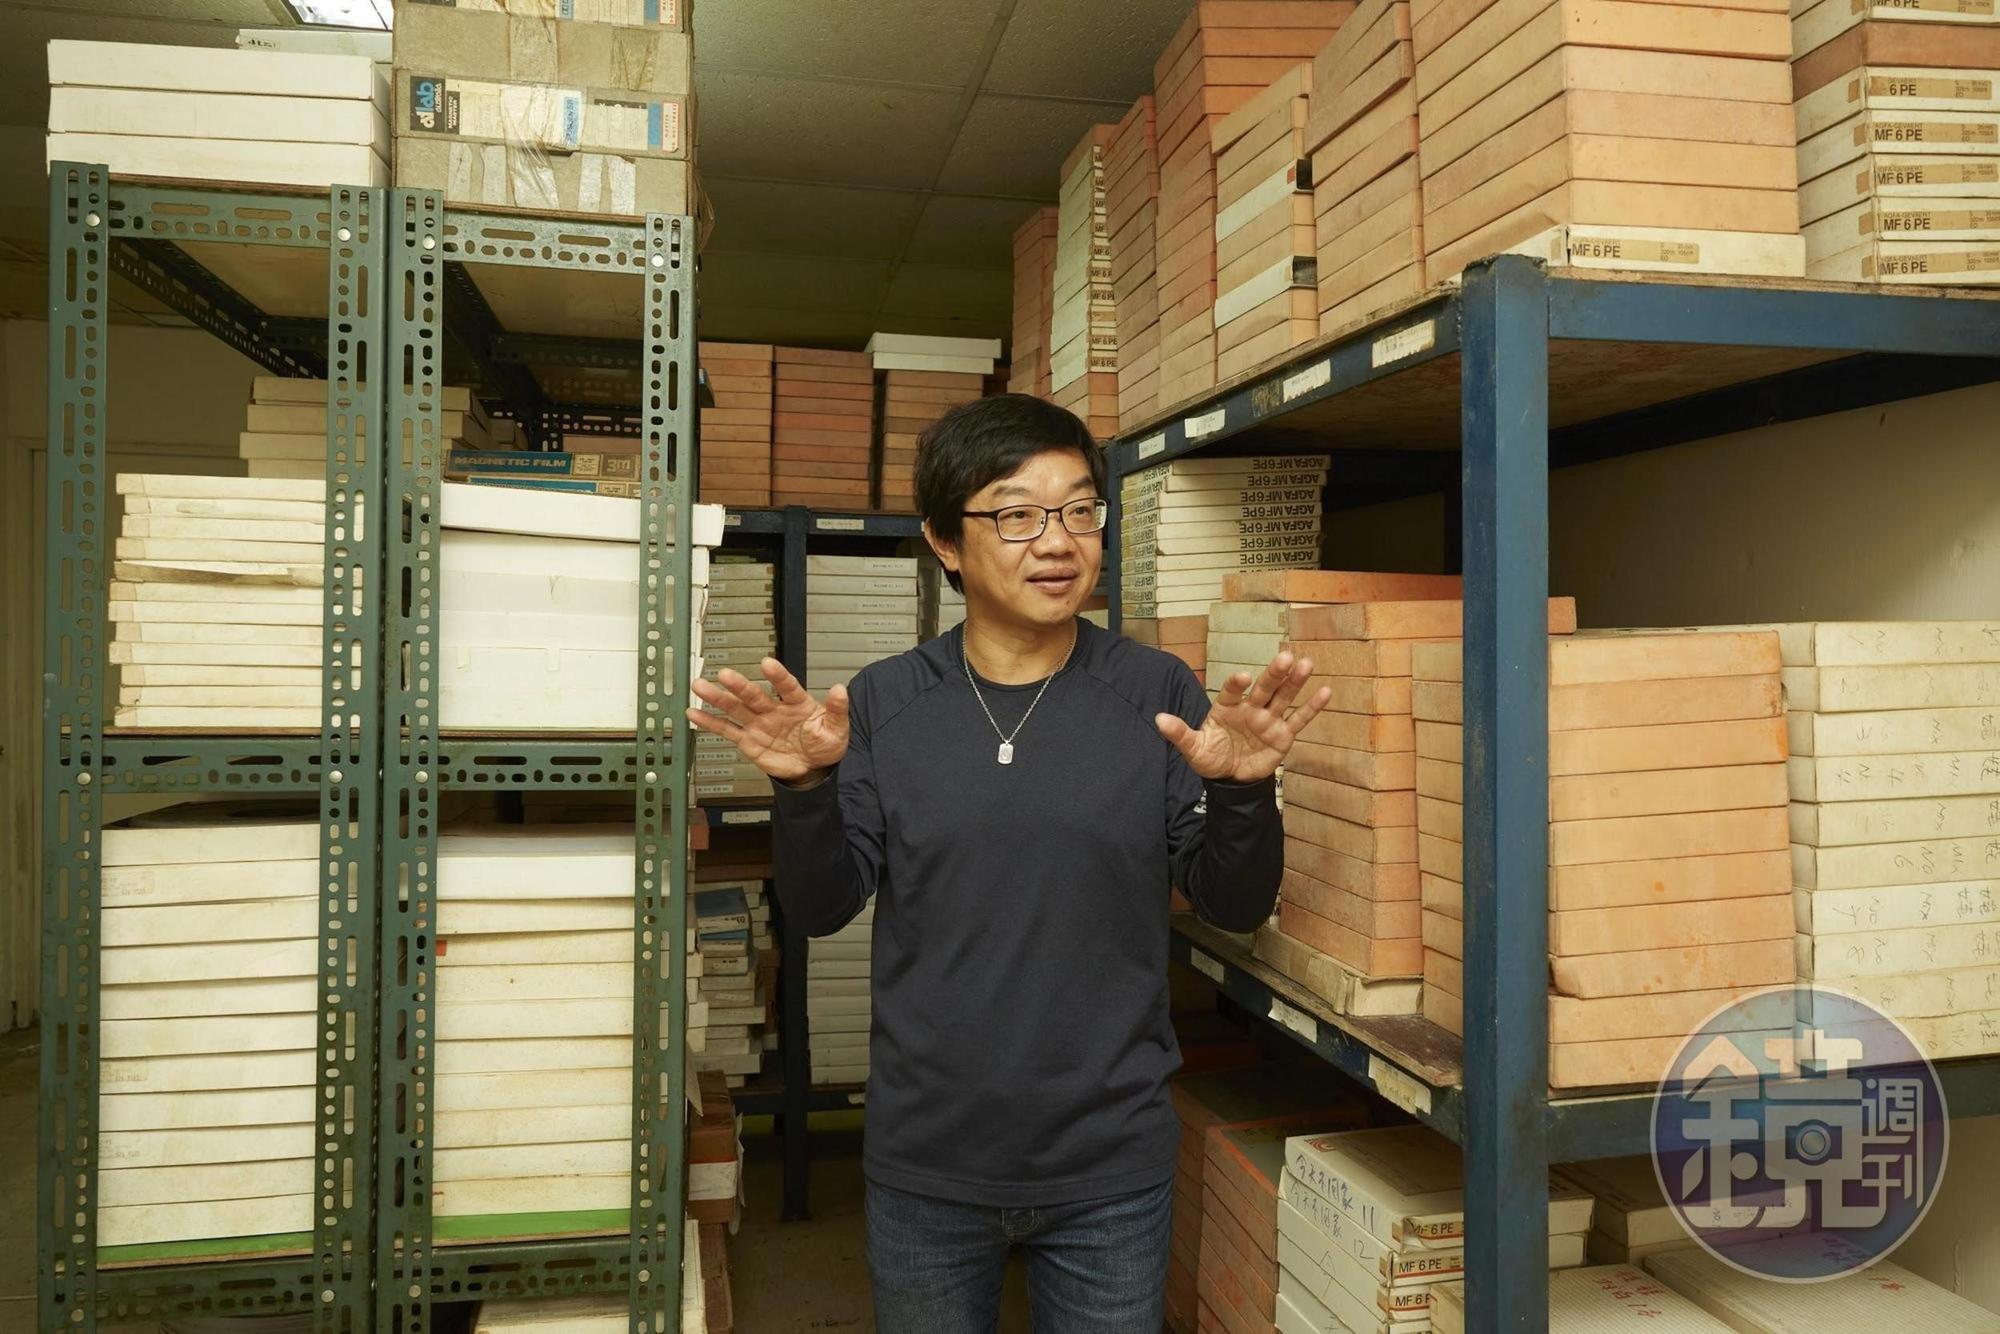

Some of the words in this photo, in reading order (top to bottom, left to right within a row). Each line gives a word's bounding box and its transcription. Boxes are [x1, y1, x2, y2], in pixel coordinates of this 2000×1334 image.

[1890, 84, 1897, 96] 6
[1900, 84, 1917, 96] PE
[1874, 129, 1893, 141] MF
[1896, 129, 1903, 141] 6
[1906, 129, 1923, 141] PE
[1877, 172, 1894, 184] MF
[1896, 172, 1904, 184] 6
[1906, 172, 1923, 184] PE
[1884, 219, 1901, 231] MF
[1904, 219, 1911, 231] 6
[1914, 218, 1930, 230] PE
[1572, 244, 1591, 257] MF
[1593, 244, 1601, 257] 6
[1603, 245, 1621, 258] PE
[1880, 263, 1898, 274] MF
[1901, 262, 1908, 274] 6
[1911, 261, 1928, 273] PE
[454, 456, 530, 466] MAGNETIC
[533, 458, 566, 468] FILM
[1294, 456, 1323, 469] AGFA
[1290, 473, 1320, 485] AGFA
[1284, 489, 1315, 501] AGFA
[1284, 504, 1315, 516] AGFA
[1283, 519, 1314, 531] AGFA
[1284, 534, 1314, 546] AGFA
[1284, 550, 1313, 562] AGFA
[1431, 1224, 1438, 1235] 6
[1440, 1223, 1453, 1233] PE
[1354, 1239, 1375, 1260] 12
[1398, 1261, 1414, 1273] MF
[1418, 1260, 1426, 1271] 6
[1429, 1259, 1442, 1270] PE
[1395, 1295, 1412, 1306] MF
[1415, 1294, 1422, 1305] 6
